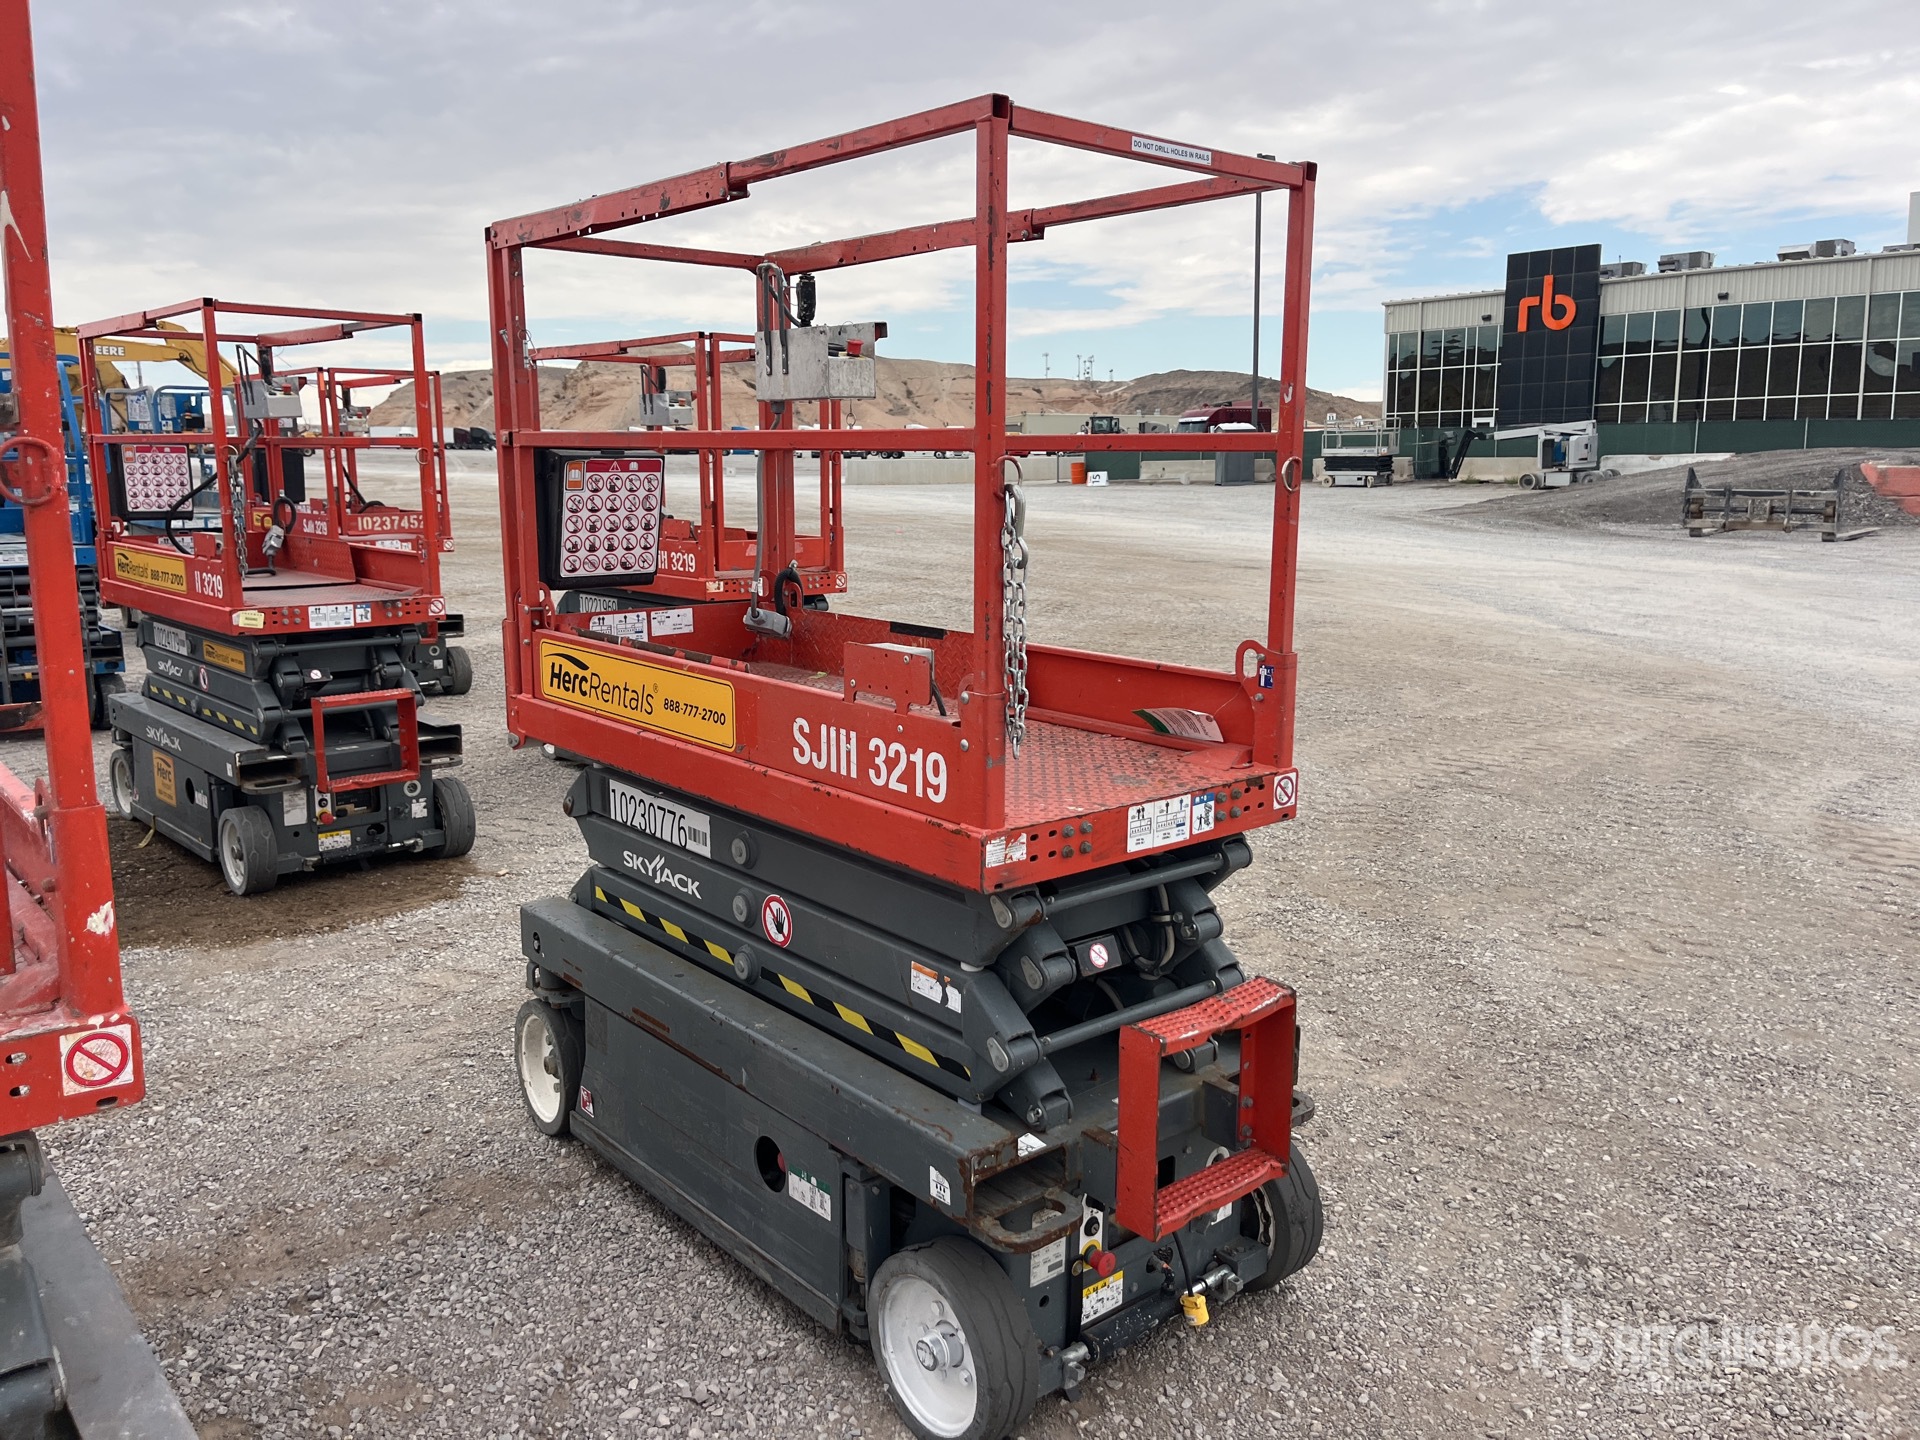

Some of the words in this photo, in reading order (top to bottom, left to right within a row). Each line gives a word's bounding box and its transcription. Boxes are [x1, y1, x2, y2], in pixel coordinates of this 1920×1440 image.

[1133, 139, 1142, 148] DO
[1142, 142, 1154, 151] NOT
[1154, 144, 1170, 154] DRILL
[1170, 148, 1188, 158] HOLES
[1194, 153, 1210, 162] RAILS
[1517, 274, 1577, 333] rb
[94, 345, 126, 357] EERE
[670, 551, 697, 573] 3219
[202, 572, 224, 599] 3219
[663, 698, 726, 726] 888-777-2700
[145, 724, 182, 752] SKYJACK
[867, 737, 948, 803] 3219
[611, 788, 688, 849] 10230776
[622, 850, 703, 900] SKYJACK
